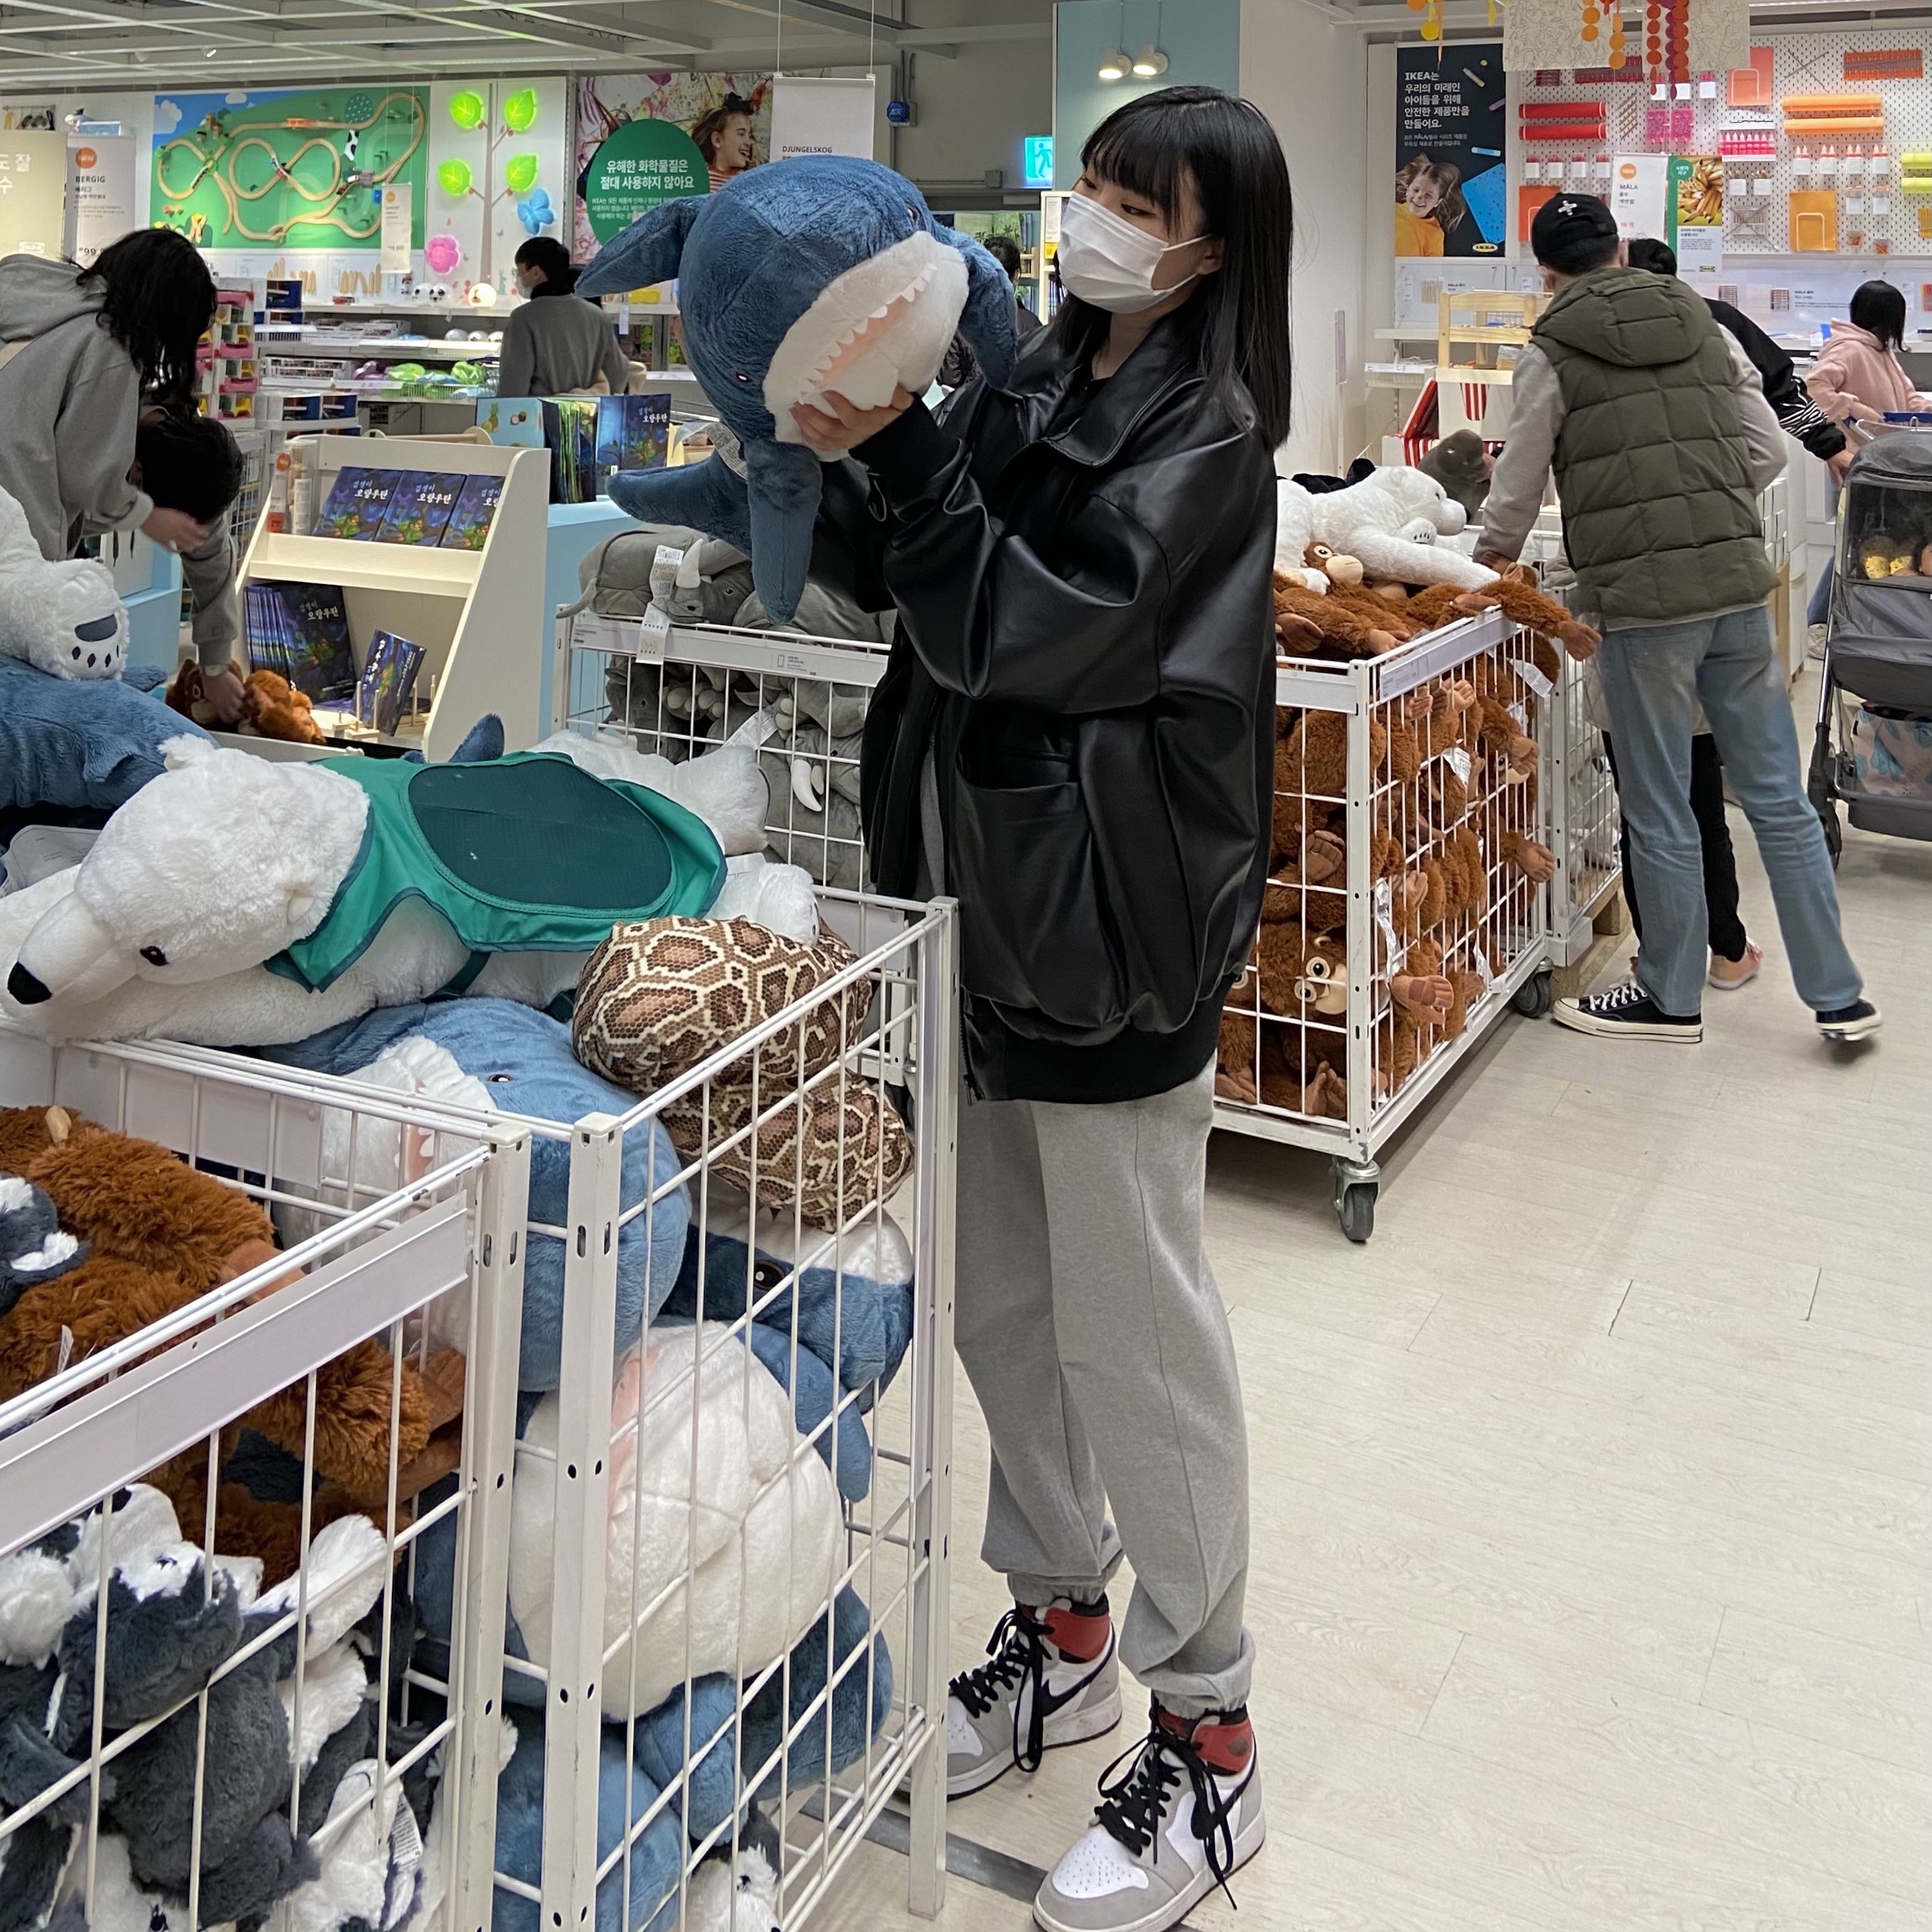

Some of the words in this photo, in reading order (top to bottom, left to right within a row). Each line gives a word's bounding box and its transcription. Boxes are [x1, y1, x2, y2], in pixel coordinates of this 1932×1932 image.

[1405, 72, 1439, 80] IKEA는
[1405, 83, 1430, 93] 우리의
[1434, 82, 1460, 93] 미래인
[1405, 95, 1440, 106] 아이들을
[1443, 94, 1461, 104] 위해
[1405, 107, 1430, 117] 안전한
[1434, 106, 1470, 117] 제품만을
[1405, 119, 1442, 129] 만들어요.
[15, 153, 31, 172] 잘
[607, 159, 636, 174] 유해한
[638, 159, 688, 173] 화학물질은
[600, 177, 619, 190] 절대
[622, 176, 661, 189] 사용하지
[664, 176, 694, 189] 않아요
[642, 413, 667, 423] 오랑우탄
[353, 480, 373, 489] 겁쟁이
[415, 484, 435, 493] 겁쟁이
[354, 489, 388, 500] 오랑우탄
[417, 493, 451, 504] 오랑우탄
[307, 606, 339, 620] 오랑우탄
